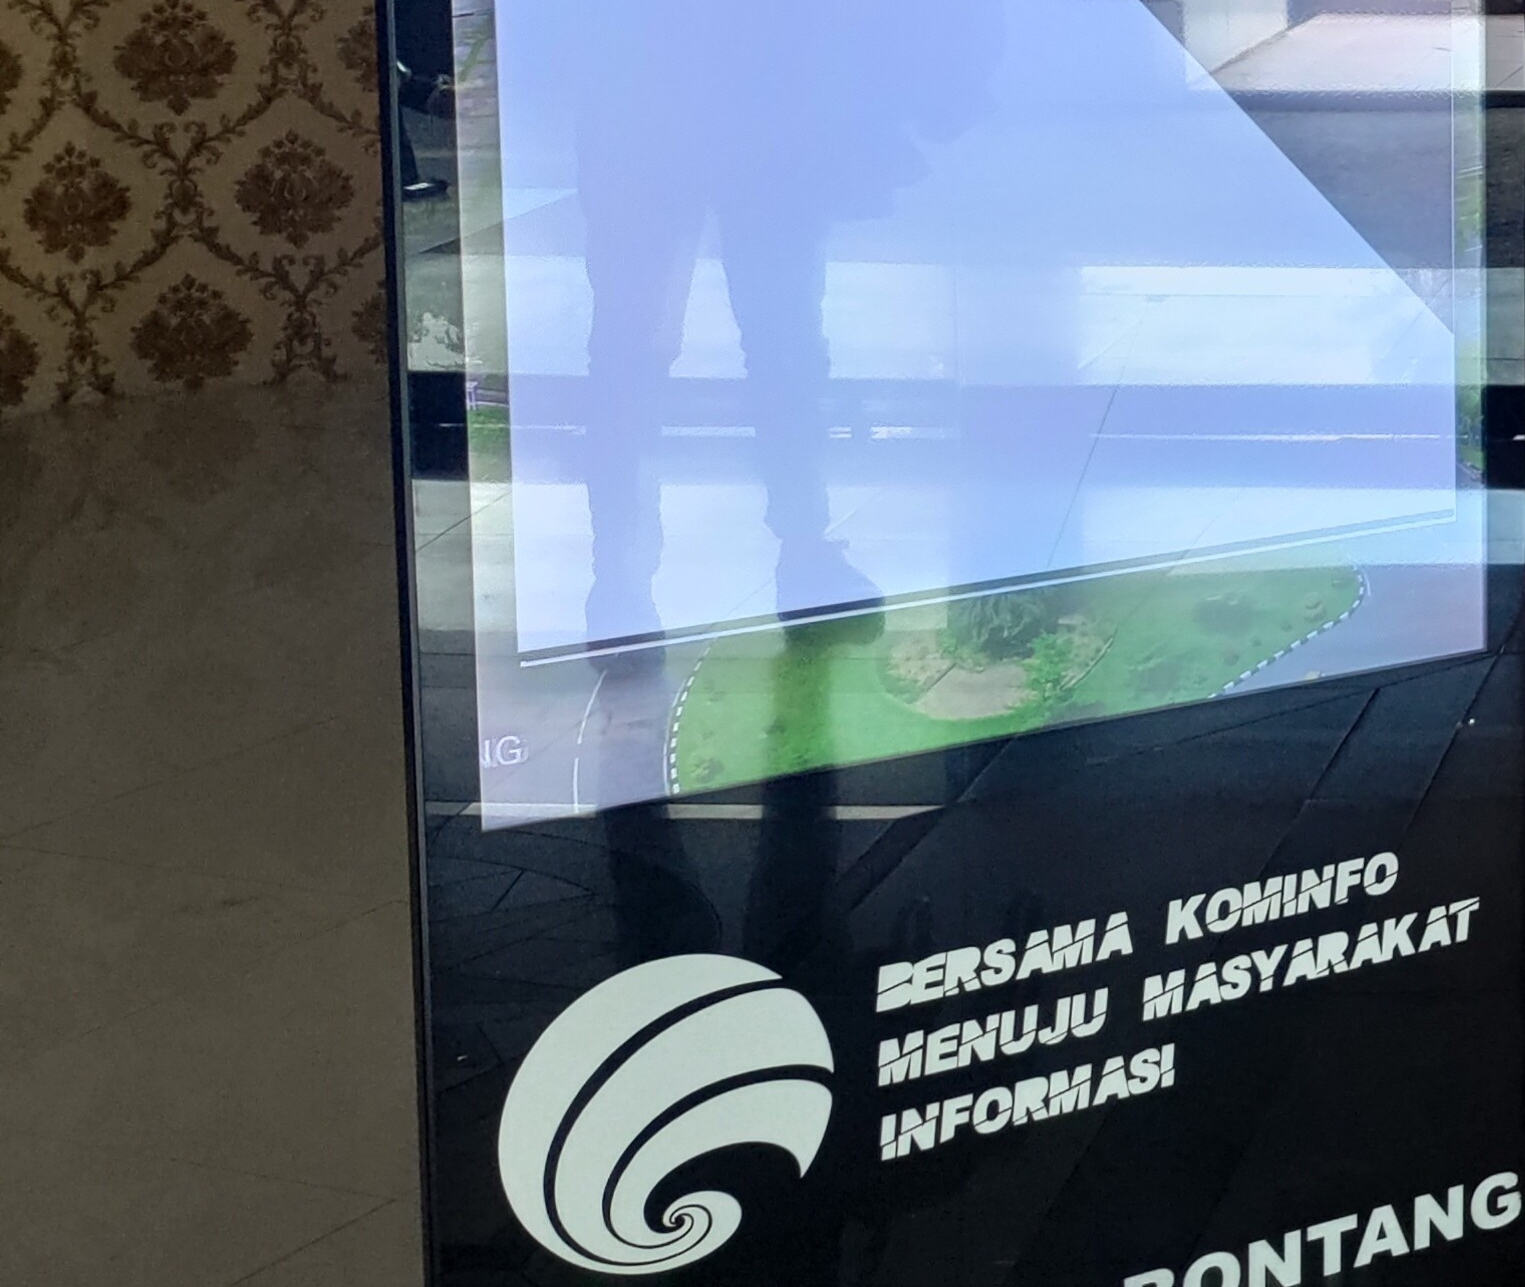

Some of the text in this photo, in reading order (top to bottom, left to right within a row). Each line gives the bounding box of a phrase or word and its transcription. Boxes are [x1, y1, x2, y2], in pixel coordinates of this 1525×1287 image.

[876, 852, 1399, 1012] BERSAMA KOMINFO
[877, 896, 1480, 1086] MENUJU MASYARAKAT
[880, 1043, 1176, 1161] INFORMASI
